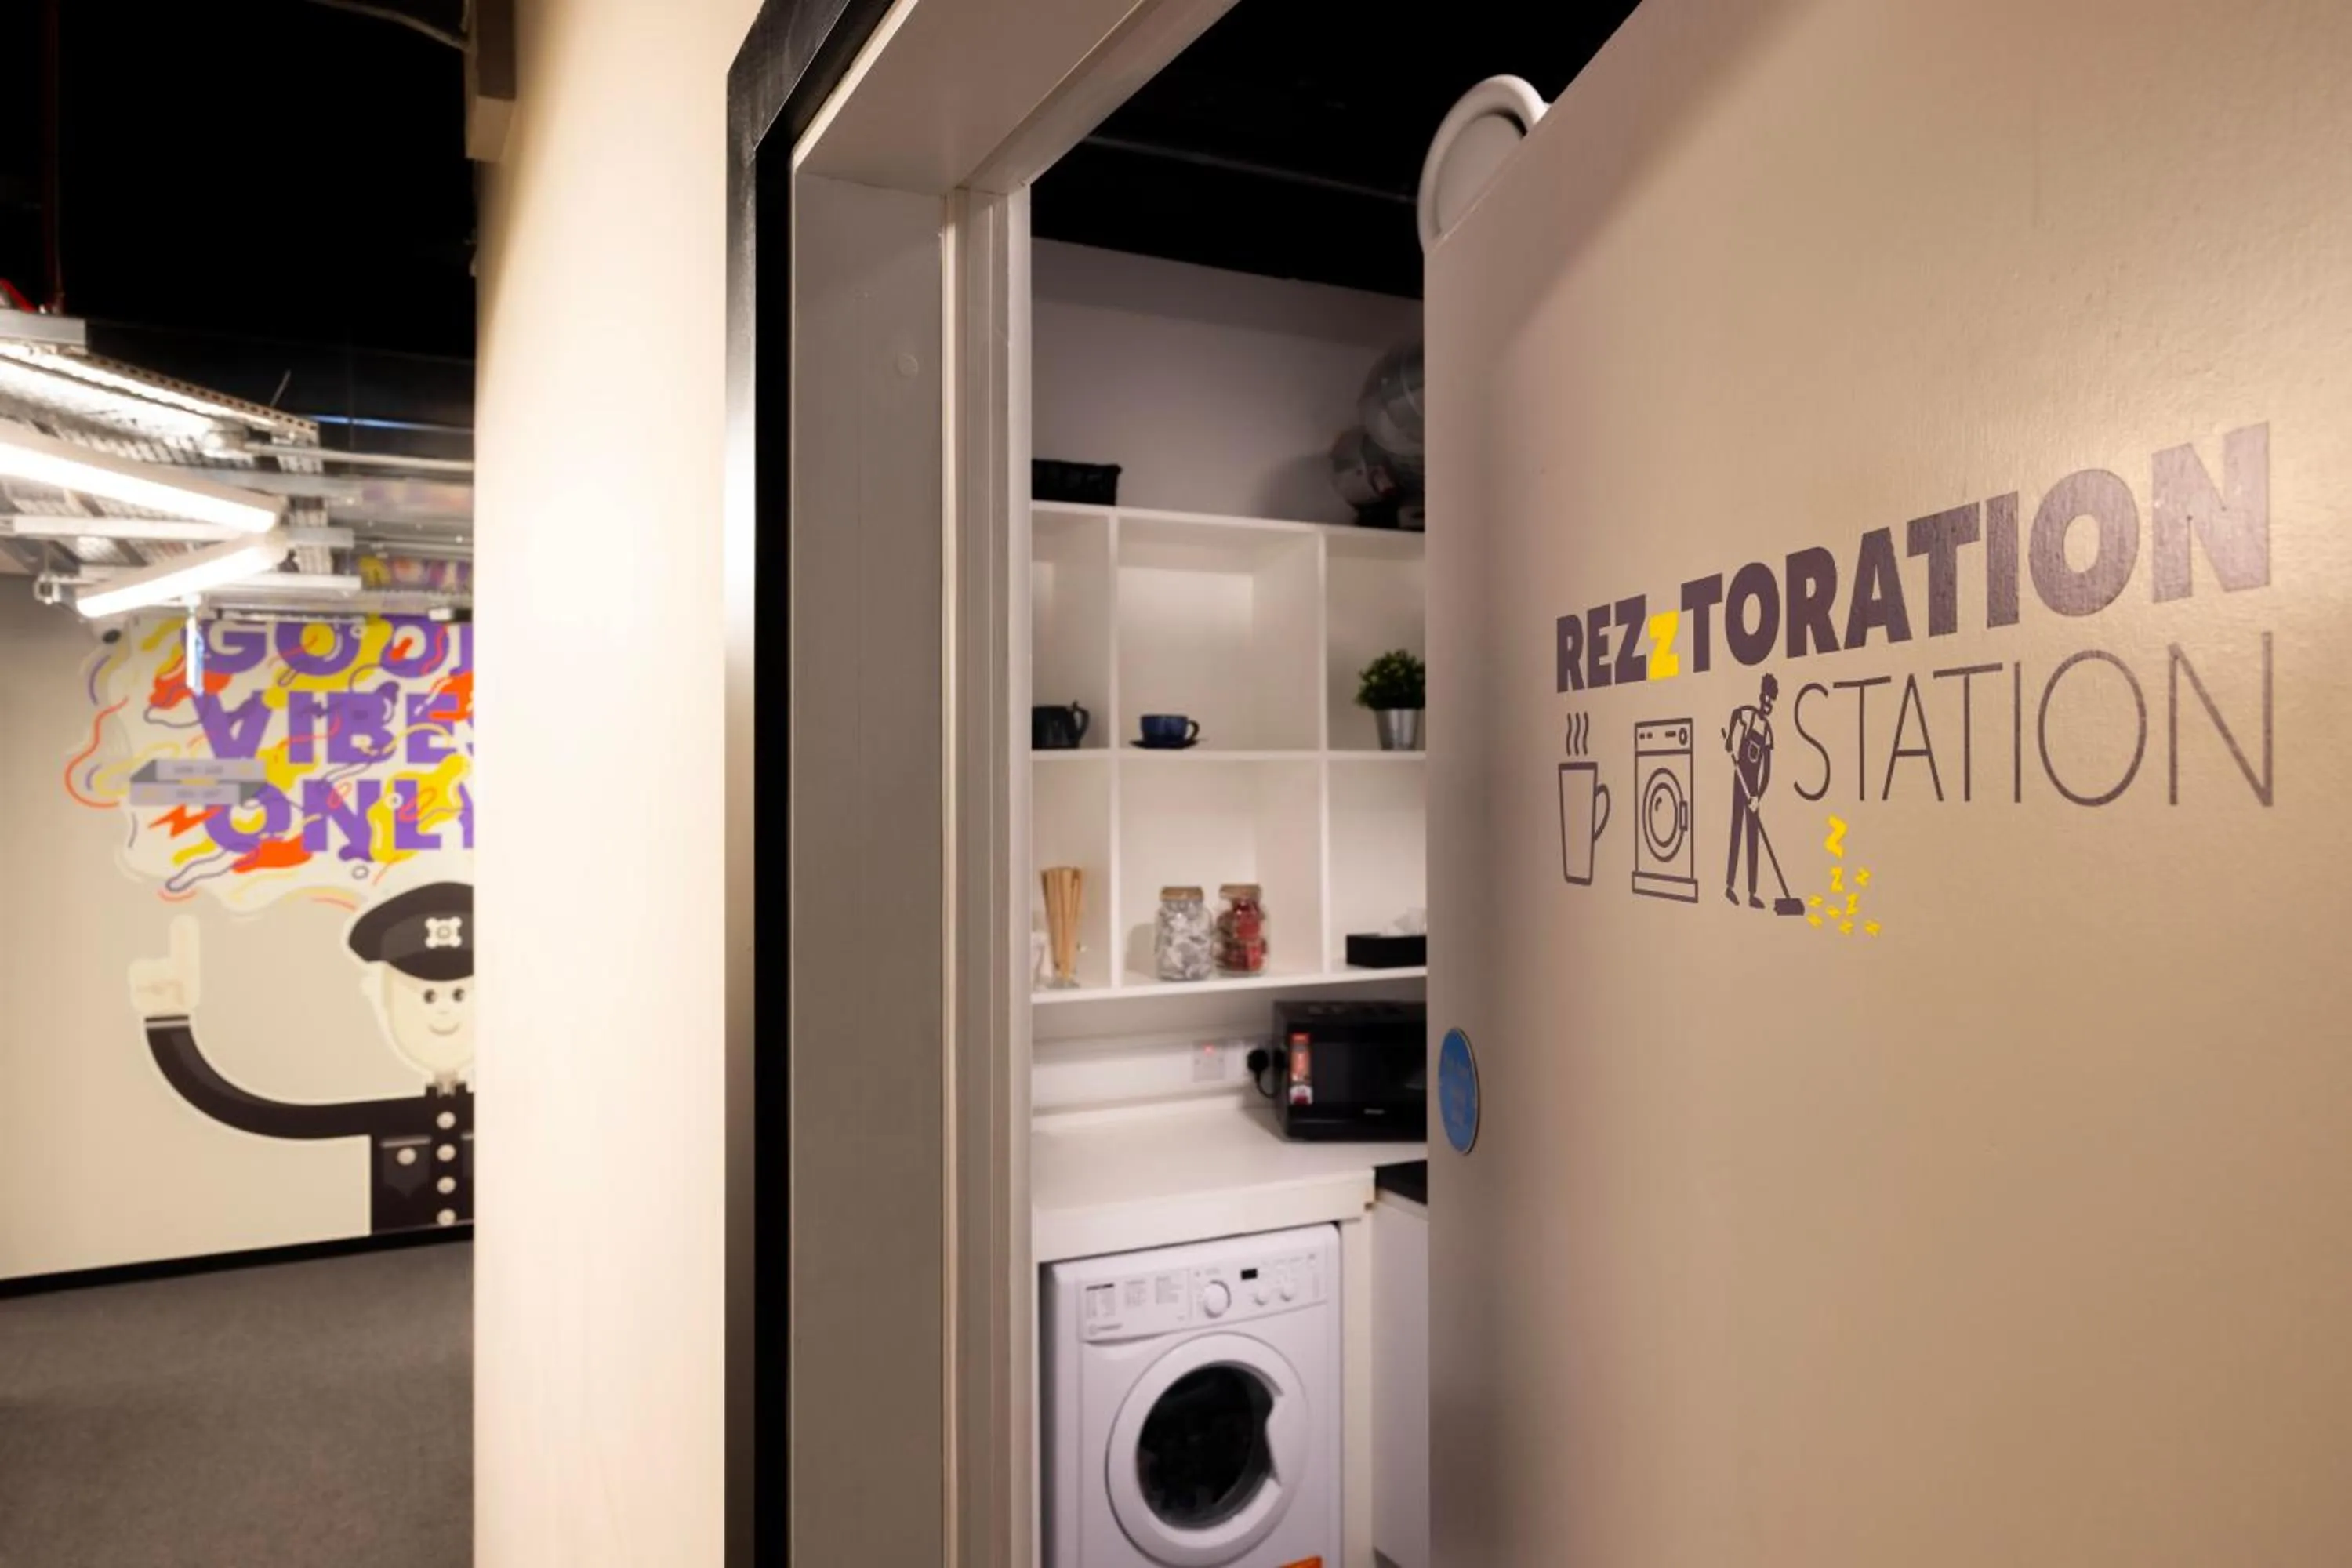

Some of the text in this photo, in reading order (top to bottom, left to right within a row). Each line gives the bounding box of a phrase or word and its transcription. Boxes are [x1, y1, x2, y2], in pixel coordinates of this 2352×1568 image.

[181, 614, 474, 679] GOO
[191, 691, 474, 764] VIBE
[1793, 631, 2273, 807] STATION
